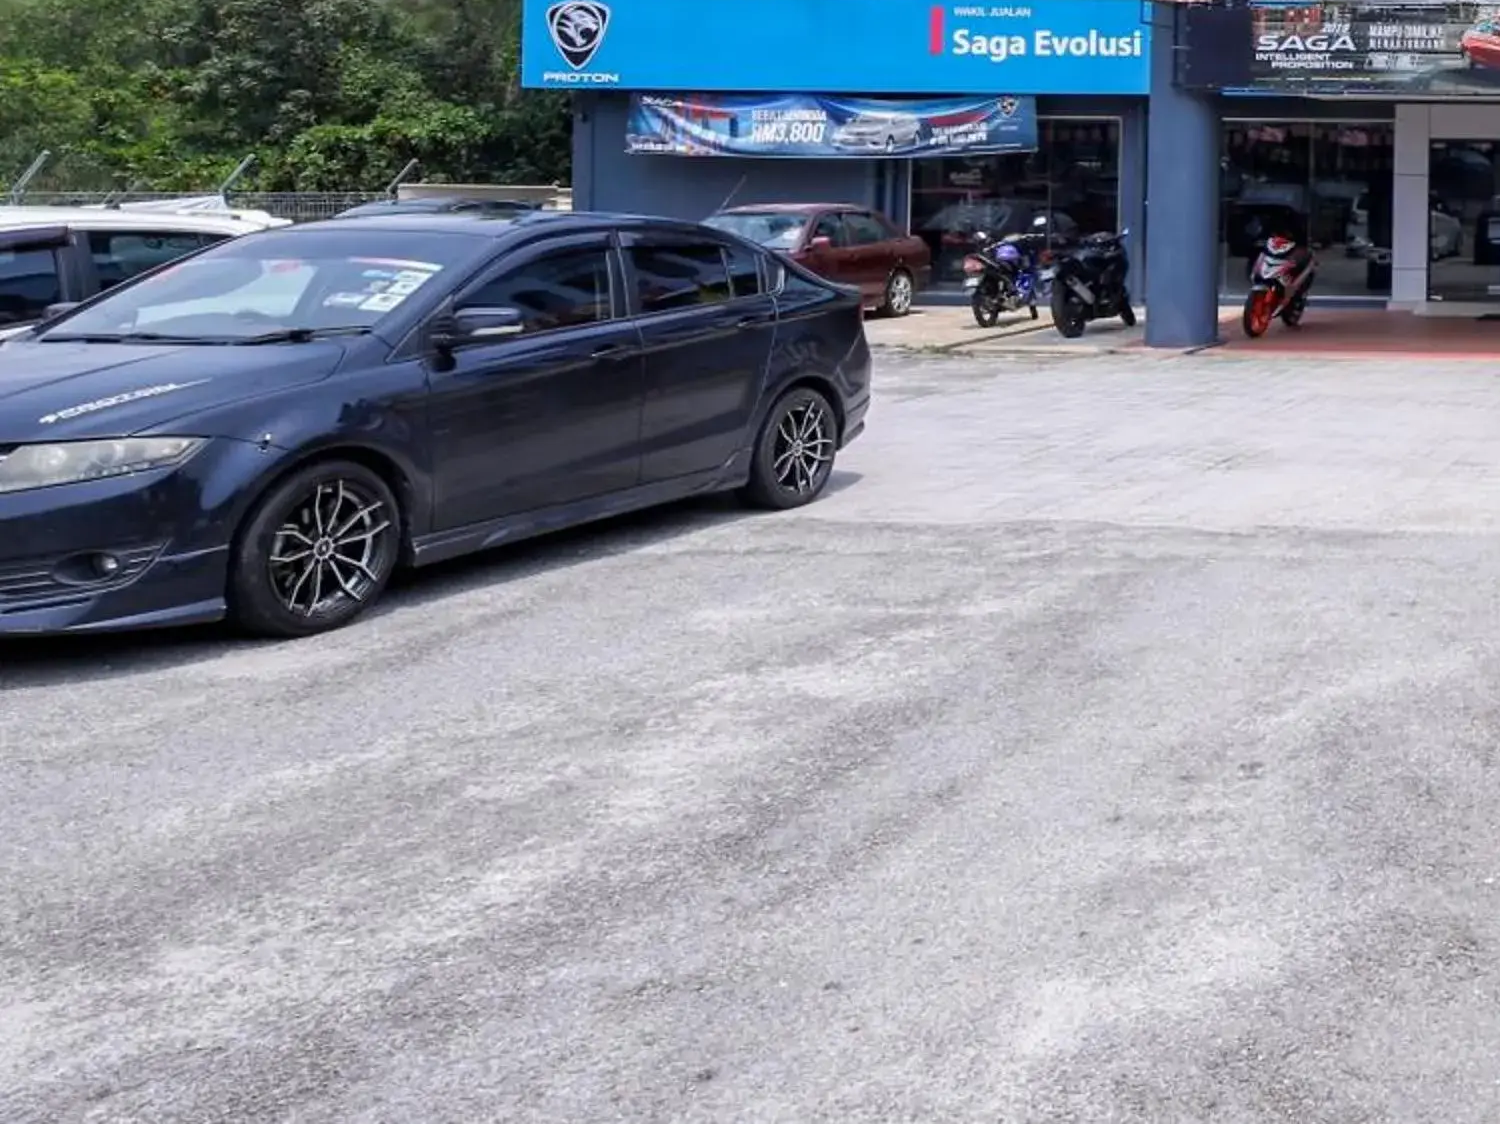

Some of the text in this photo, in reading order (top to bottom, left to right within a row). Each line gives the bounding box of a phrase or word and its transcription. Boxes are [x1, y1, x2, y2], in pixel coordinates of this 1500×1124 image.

[953, 29, 1143, 62] Saga Evolusi
[1256, 35, 1357, 50] SAGA
[1255, 53, 1332, 61] INTELLIGENT
[543, 72, 619, 83] PROTON
